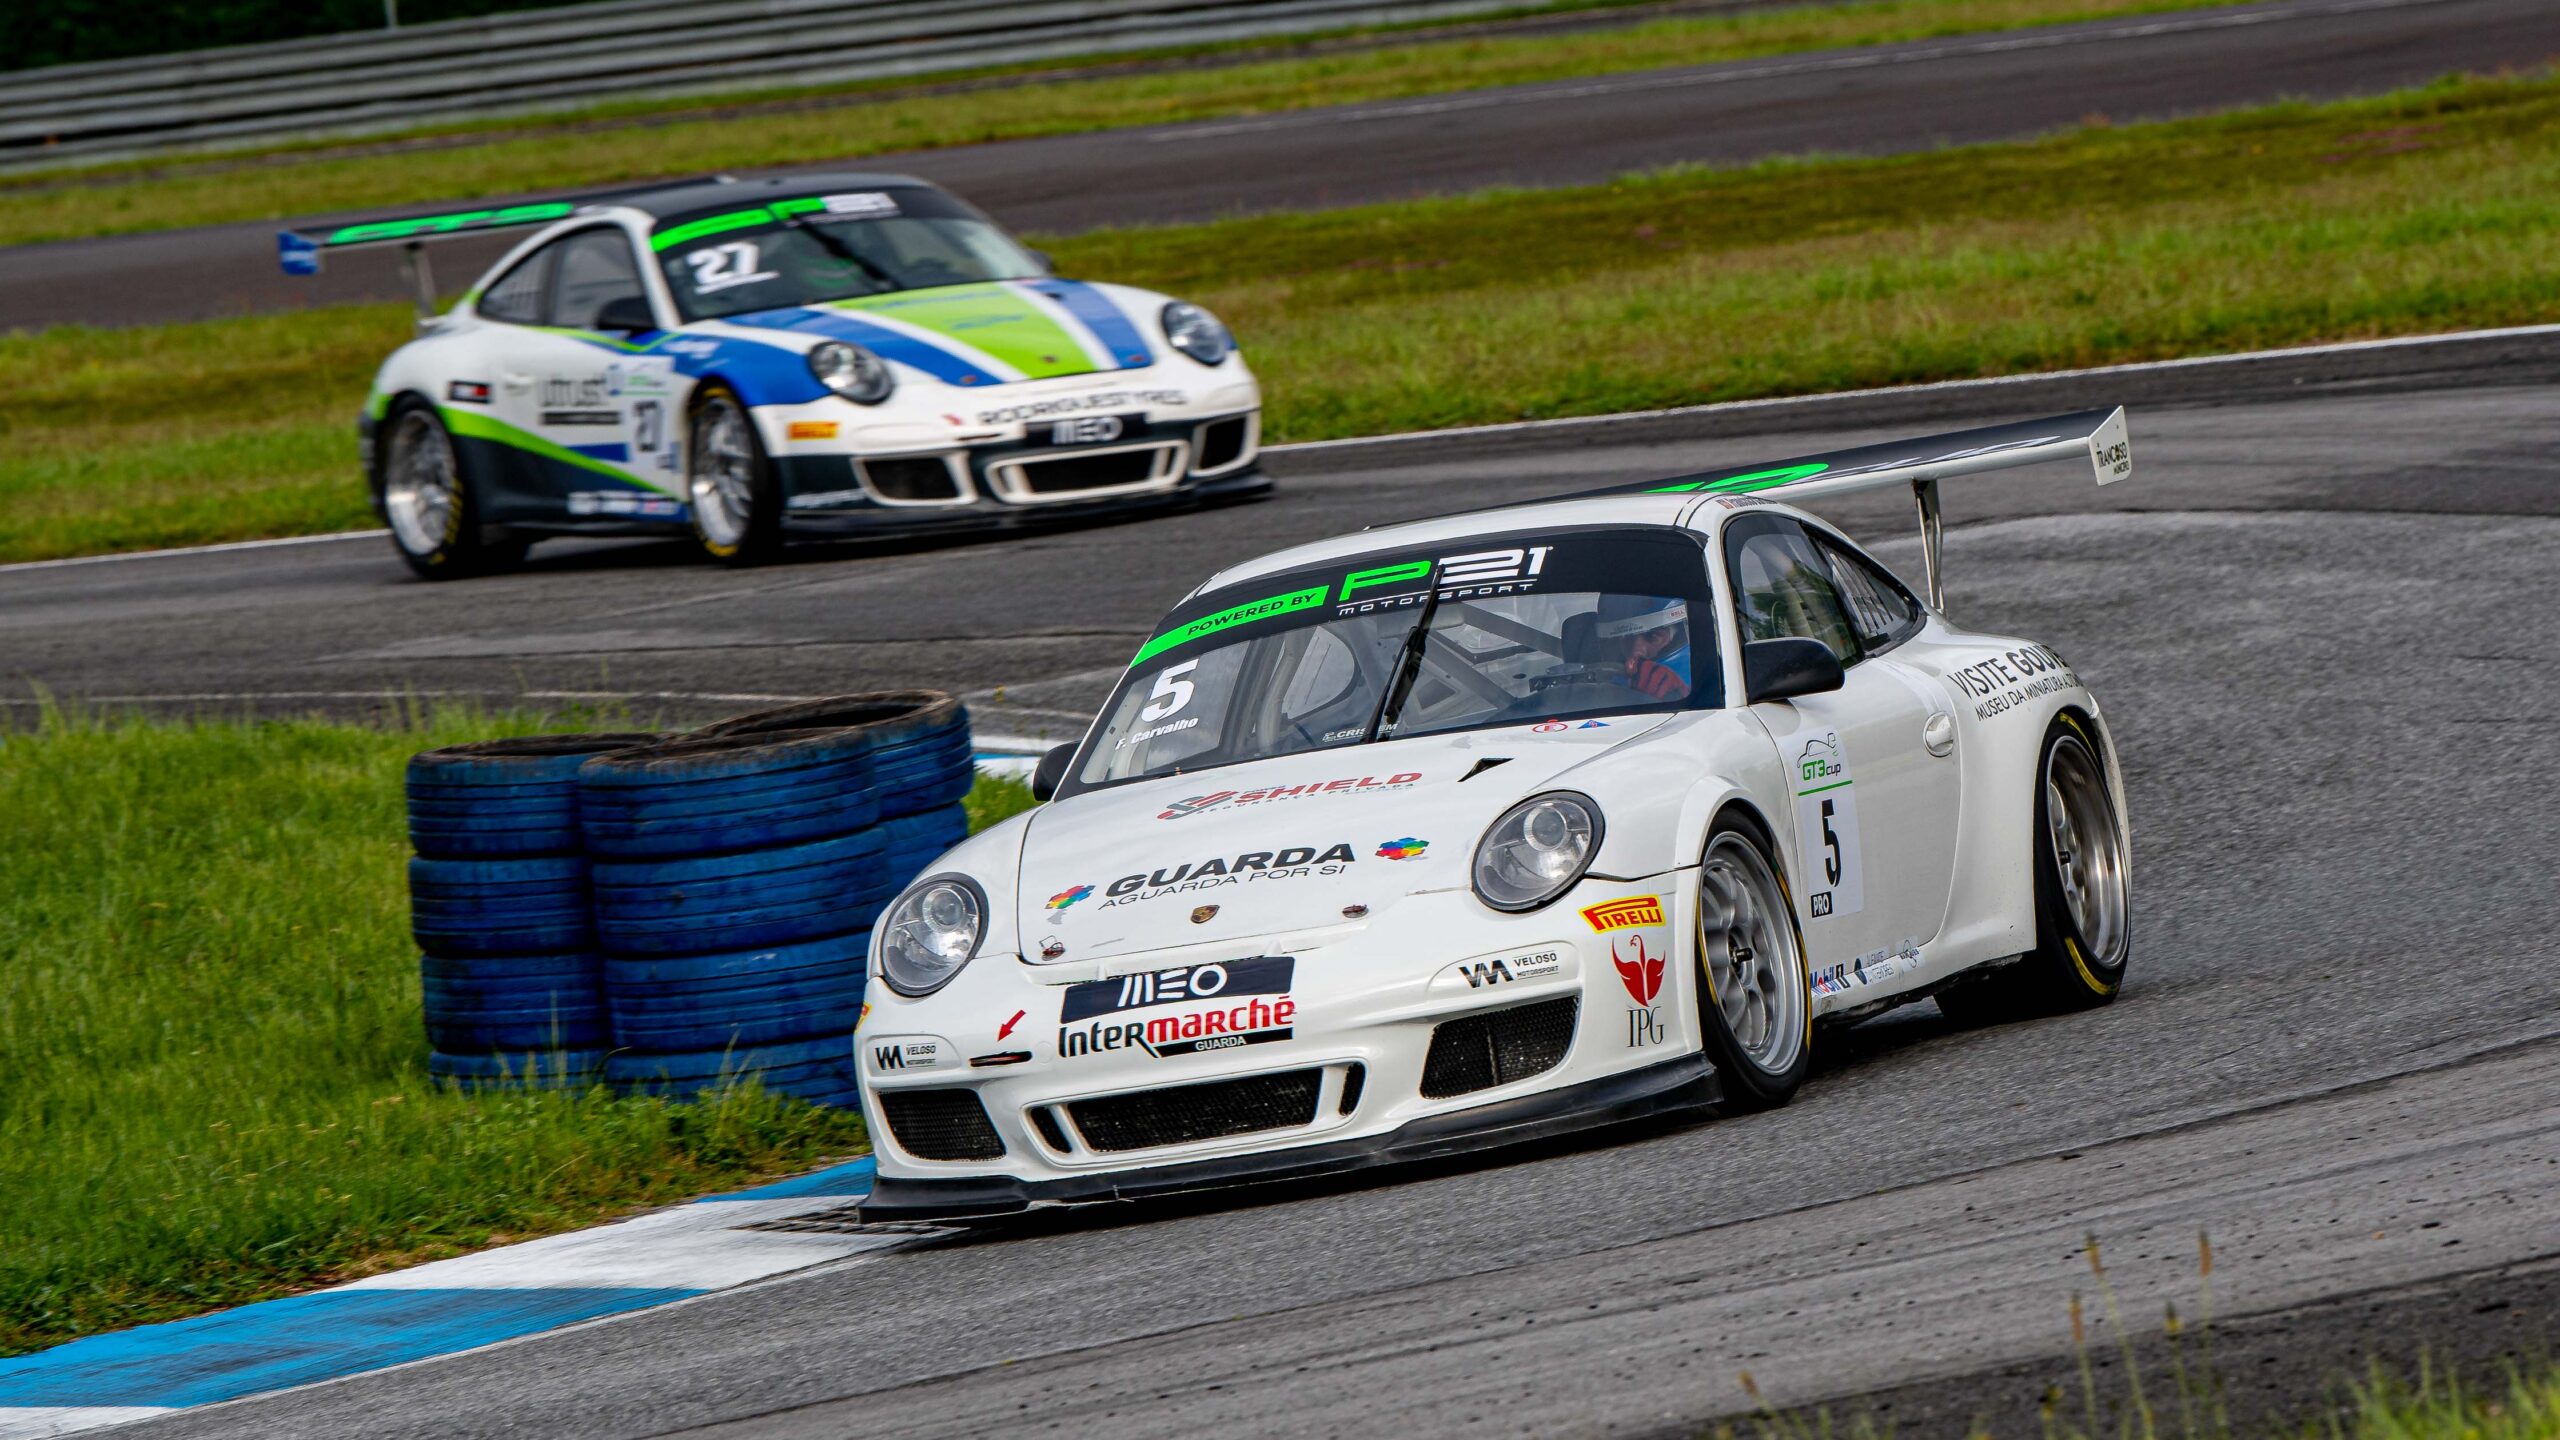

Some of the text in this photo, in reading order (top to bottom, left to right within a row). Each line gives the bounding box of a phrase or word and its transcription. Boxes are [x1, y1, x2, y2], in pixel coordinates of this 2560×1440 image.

[686, 241, 760, 285] 27
[1052, 416, 1123, 444] MEO
[1339, 546, 1547, 601] P21
[1187, 593, 1317, 636] POWERED BY
[1141, 659, 1199, 723] 5
[1947, 657, 2018, 699] VISITE
[1975, 695, 2010, 721] MUSEU
[2008, 689, 2027, 706] DA
[1115, 716, 1199, 751] F. Carvalho
[1234, 773, 1423, 803] SHIELD
[1821, 798, 1842, 887] 5
[1098, 864, 1346, 911] AGUARDA POR SI
[1105, 843, 1356, 897] GUARDA
[1582, 896, 1663, 931] PIRELLI
[1812, 895, 1830, 915] PRO
[1513, 952, 1558, 967] VELOSO
[1117, 963, 1228, 1008] MEO
[1195, 1035, 1247, 1051] GUARDA
[1626, 1006, 1665, 1048] IPG
[906, 1045, 936, 1056] VELOSO
